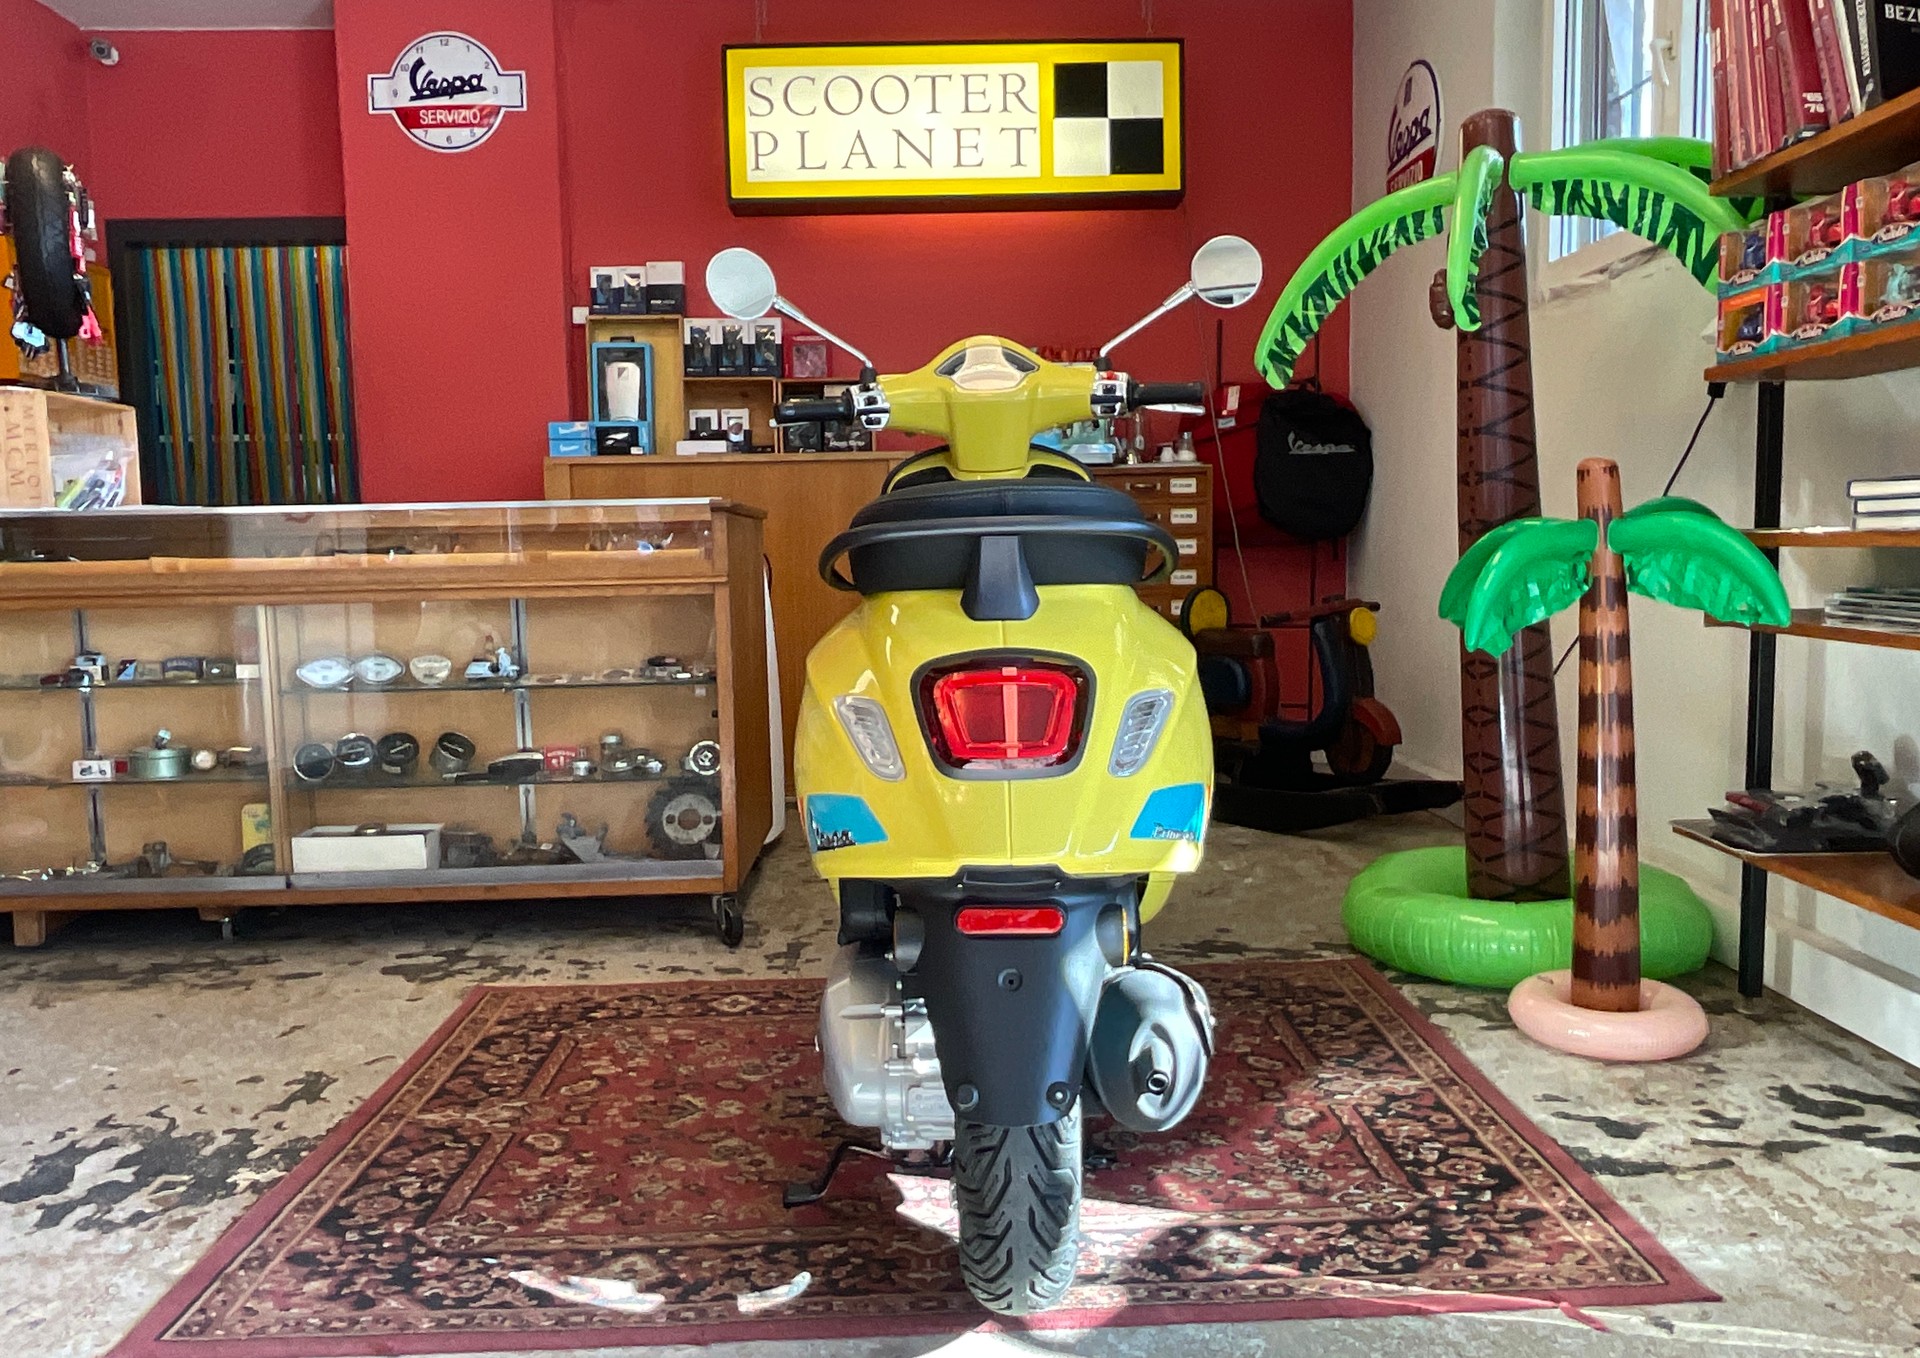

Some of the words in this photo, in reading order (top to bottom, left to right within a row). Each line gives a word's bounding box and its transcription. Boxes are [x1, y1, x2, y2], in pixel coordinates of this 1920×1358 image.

[439, 38, 450, 47] 12
[415, 46, 424, 54] 11
[465, 44, 471, 53] 1
[484, 61, 490, 70] 2
[408, 56, 488, 103] Vespa
[492, 86, 499, 95] 3
[748, 72, 1038, 117] SCOOTER
[419, 108, 481, 125] SERVIZIO
[423, 129, 429, 139] 7
[445, 135, 453, 145] 6
[750, 126, 1038, 172] PLANET
